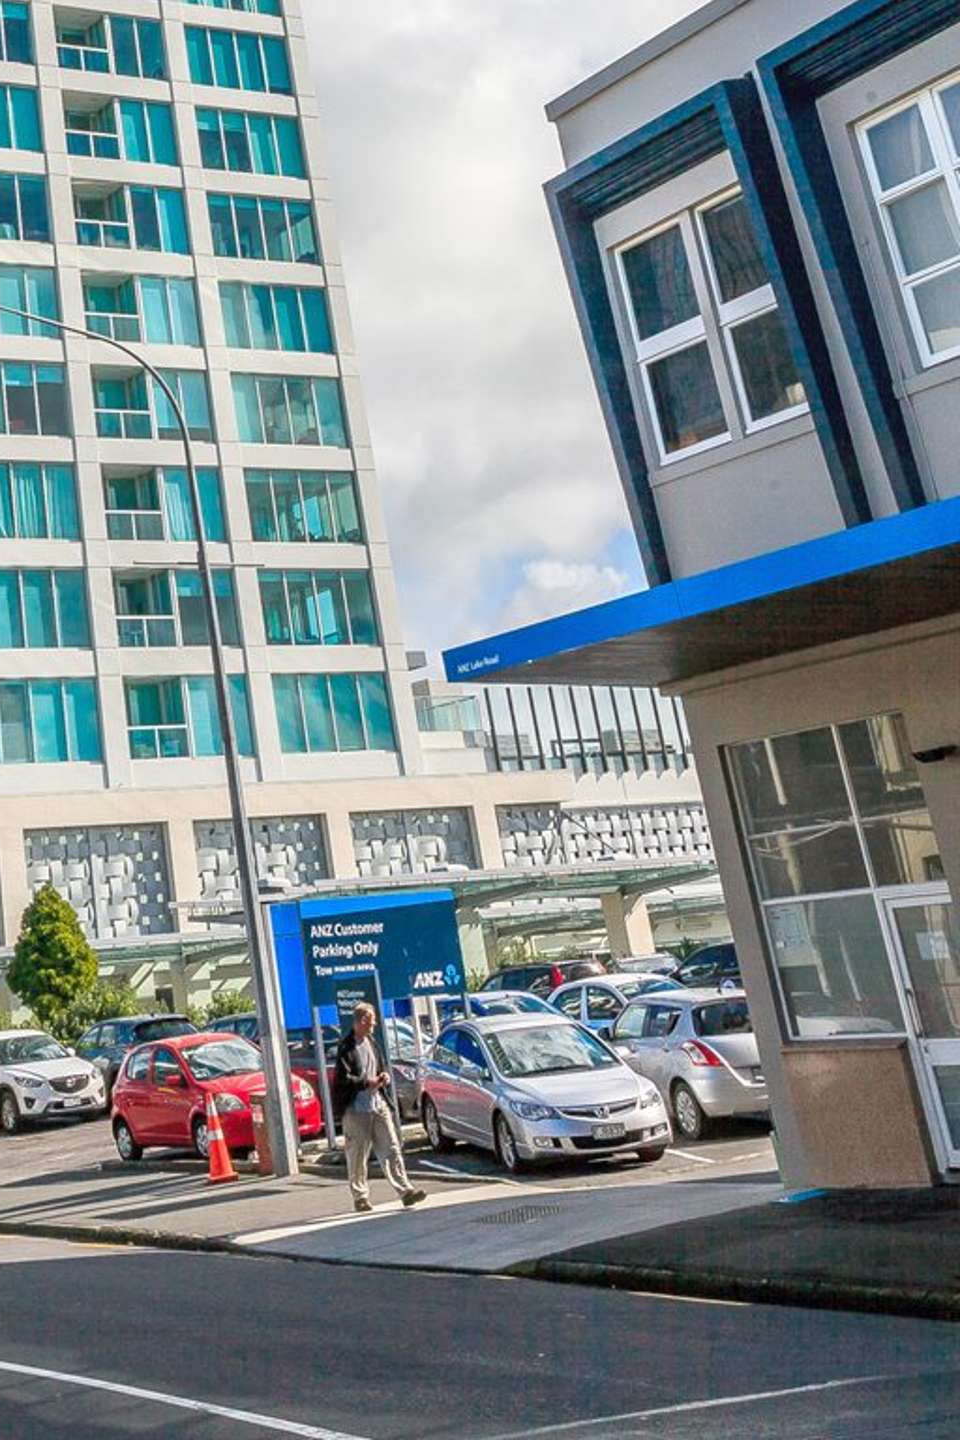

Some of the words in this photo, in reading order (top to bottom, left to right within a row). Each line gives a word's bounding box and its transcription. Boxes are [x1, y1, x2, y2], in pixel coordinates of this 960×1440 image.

[310, 924, 334, 938] ANZ
[334, 922, 383, 936] Customer
[312, 943, 353, 959] Parking
[353, 941, 379, 957] Only
[413, 970, 445, 988] ANZ
